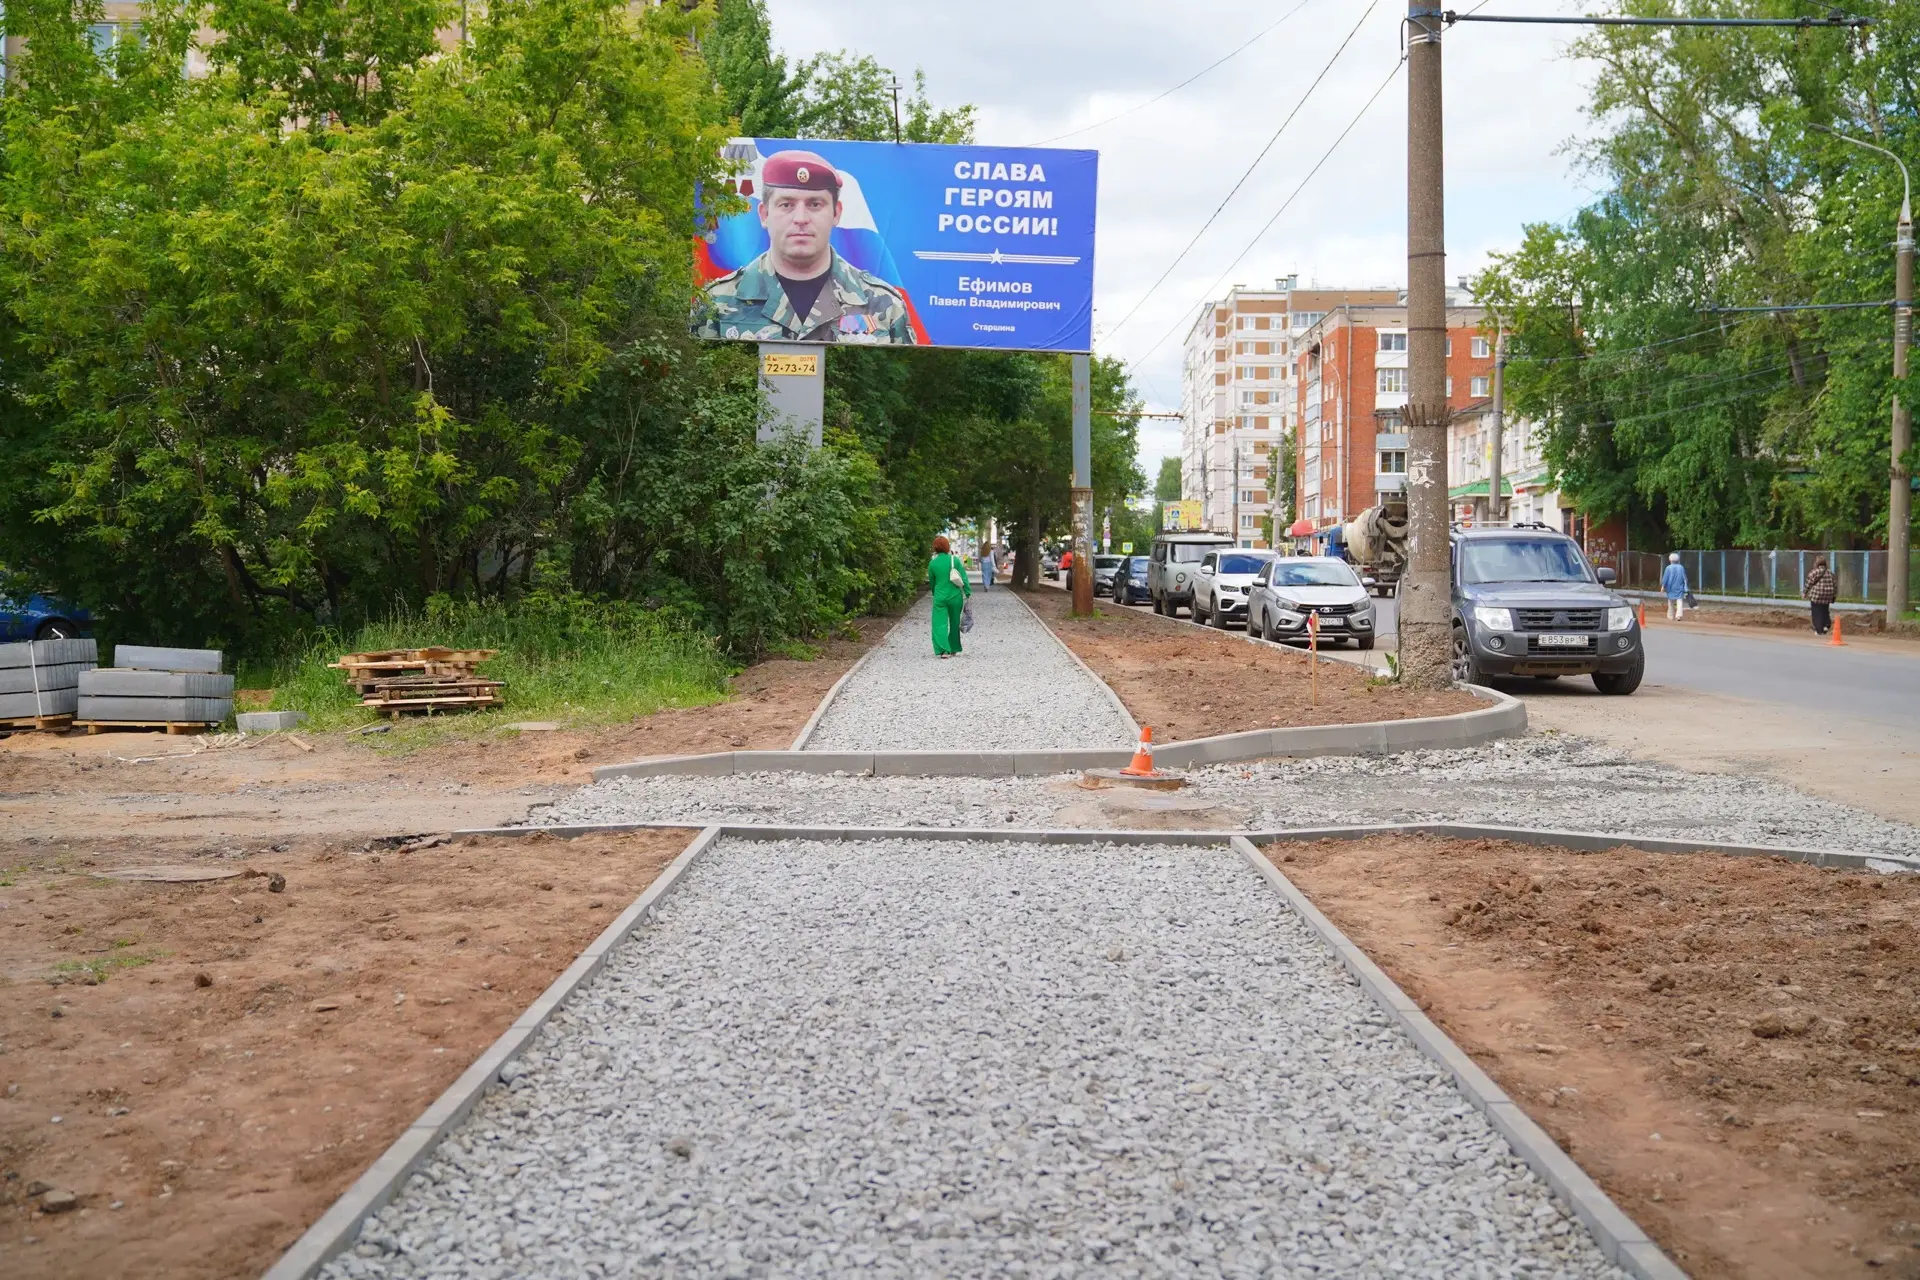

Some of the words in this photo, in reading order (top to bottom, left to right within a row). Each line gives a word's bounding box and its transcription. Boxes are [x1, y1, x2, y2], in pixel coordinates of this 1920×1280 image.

[954, 161, 1046, 182] СЛАВА
[945, 187, 1053, 209] ГЕРОЯМ
[938, 213, 1058, 236] РОССИИ!
[958, 276, 1033, 295] Ефимов
[929, 295, 966, 307] Павел
[969, 297, 1061, 311] Владимирович
[972, 322, 1016, 333] Старшина
